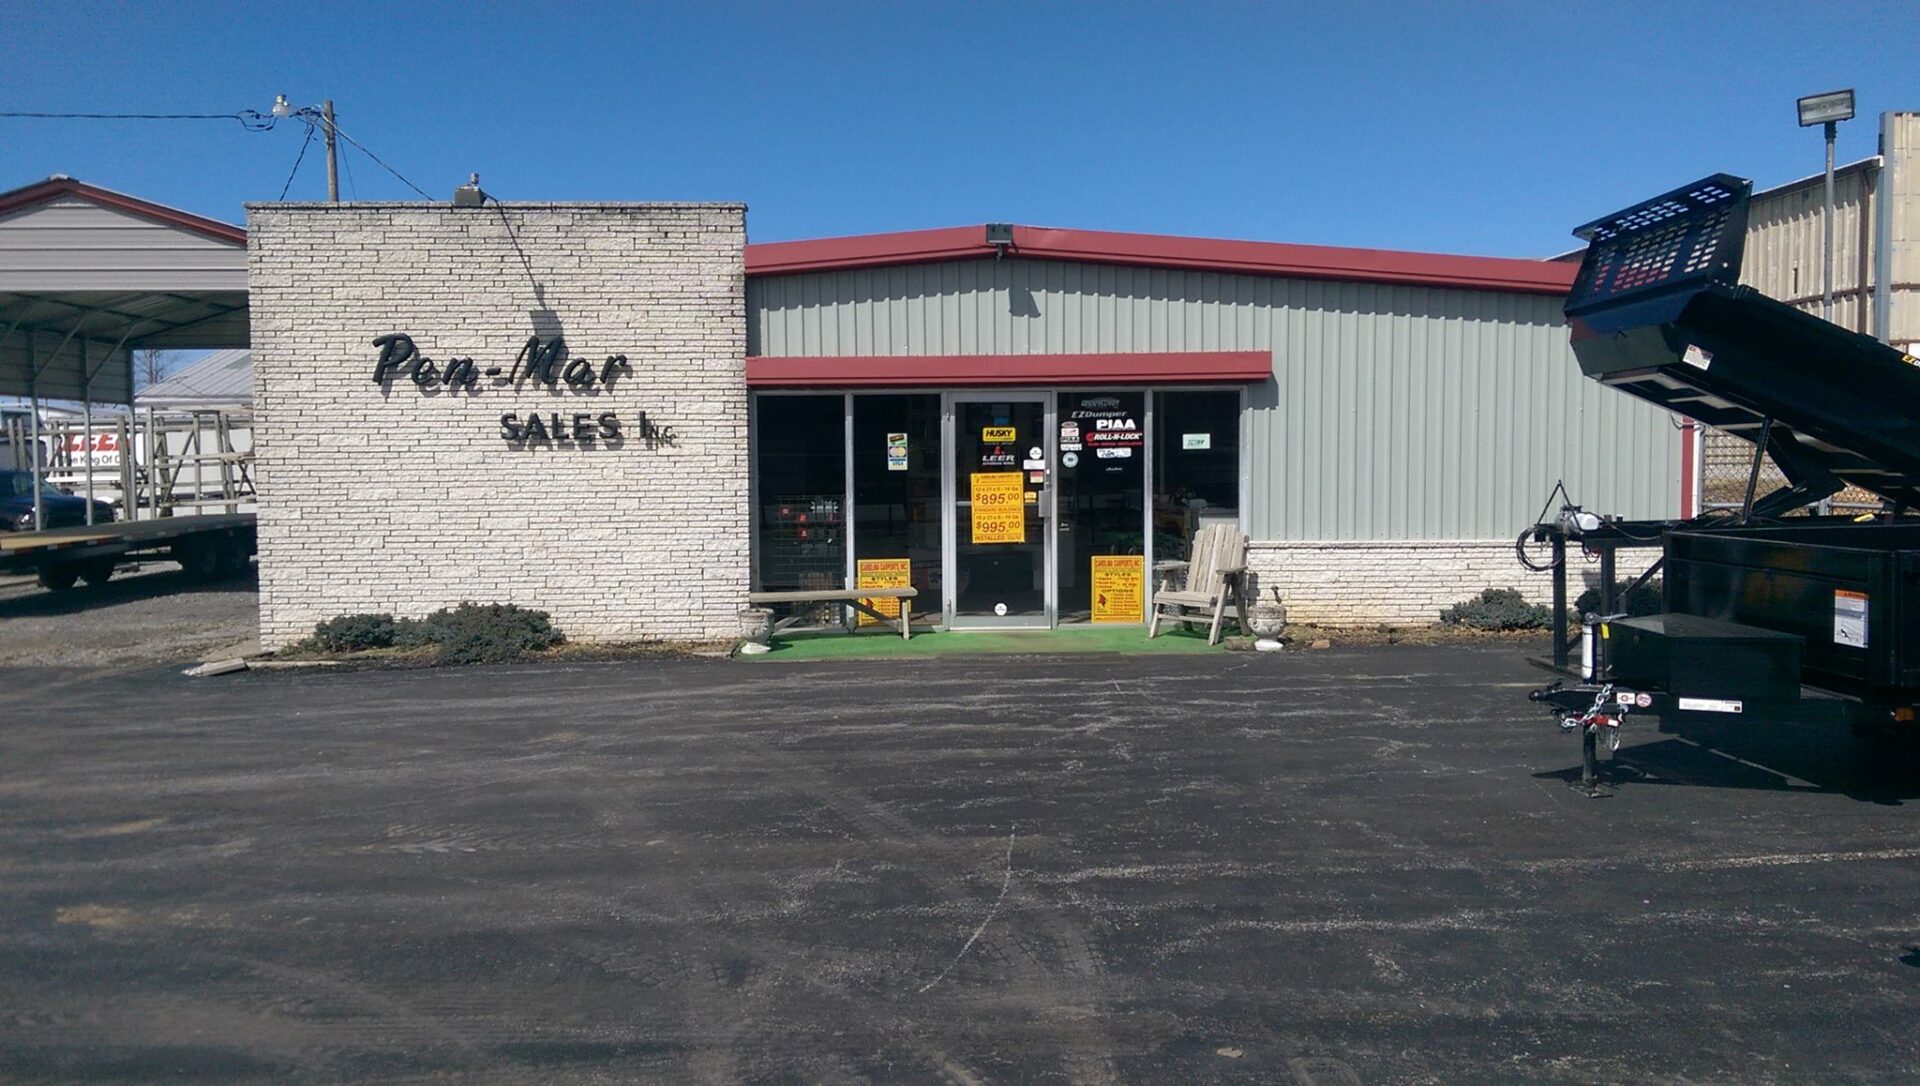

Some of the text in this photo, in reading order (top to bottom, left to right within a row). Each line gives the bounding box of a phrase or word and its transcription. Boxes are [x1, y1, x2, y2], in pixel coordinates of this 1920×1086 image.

[372, 333, 628, 385] Pen-Mar
[501, 413, 618, 440] SALES
[1097, 419, 1136, 429] PIAA
[986, 430, 1013, 438] HUSKY
[1094, 433, 1140, 441] ROLL-N-LOCK
[976, 493, 1020, 505] $895.00
[976, 521, 1021, 533] $995.00
